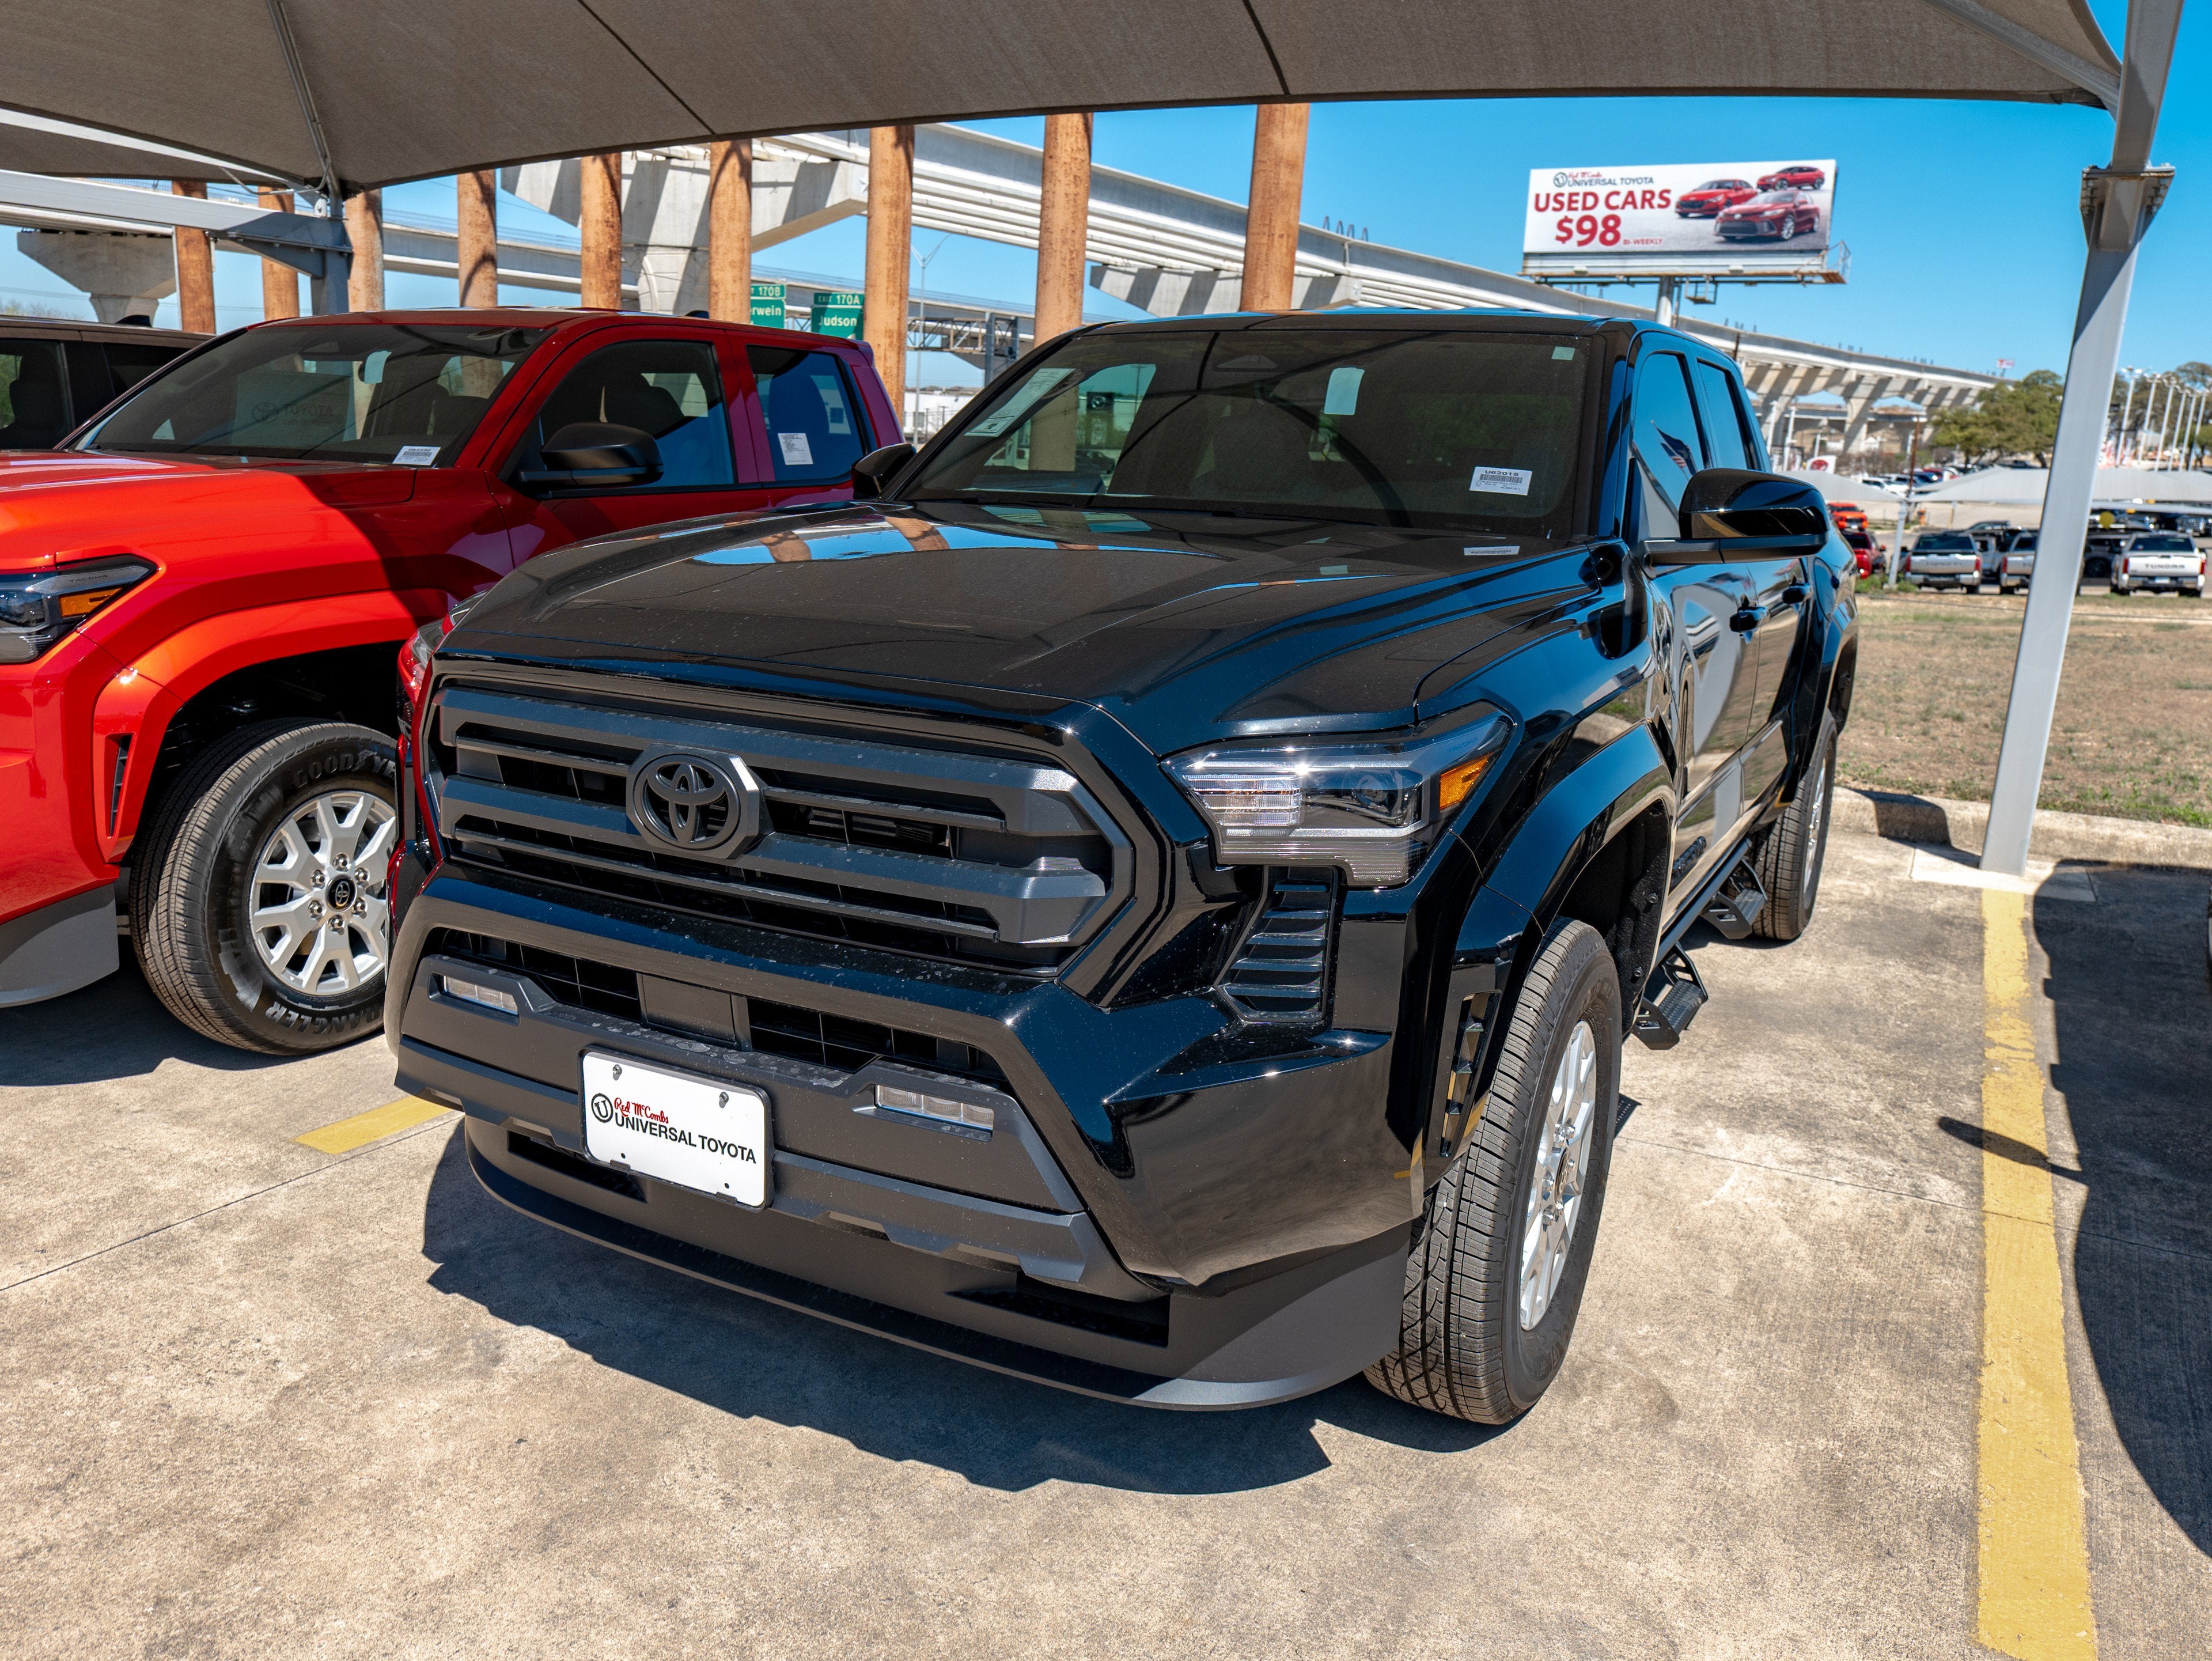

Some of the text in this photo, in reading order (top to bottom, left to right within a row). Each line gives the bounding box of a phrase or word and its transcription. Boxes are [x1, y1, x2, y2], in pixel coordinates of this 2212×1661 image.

[1568, 177, 1654, 187] UNIVERSAL TOYOTA
[1534, 189, 1672, 213] USED CARS
[1555, 214, 1622, 247] $98
[759, 286, 781, 296] 170B
[836, 294, 861, 305] 170A
[751, 305, 782, 316] rwein
[818, 315, 858, 327] Judson
[68, 574, 108, 583] TACOMA
[1446, 736, 1479, 753] TACOMA
[614, 1097, 669, 1124] Red McCombs
[615, 1112, 756, 1164] UNIVERSAL TOYOTA
